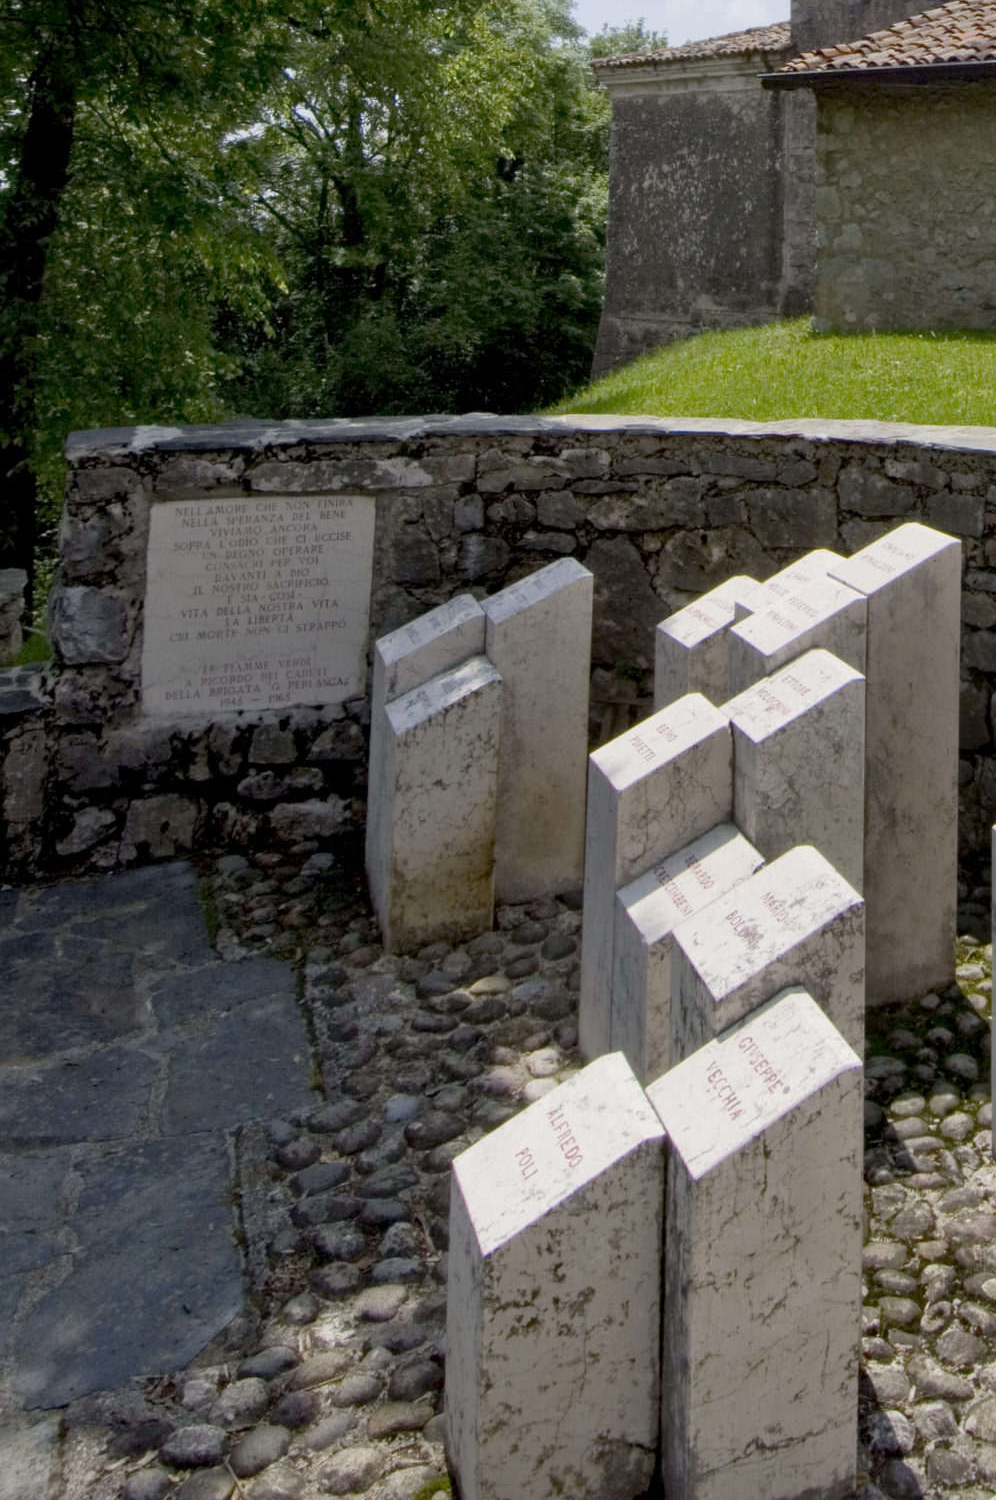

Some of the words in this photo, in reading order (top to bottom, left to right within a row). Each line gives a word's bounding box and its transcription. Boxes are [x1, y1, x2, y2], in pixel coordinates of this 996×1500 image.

[256, 502, 278, 512] CHE
[286, 499, 310, 510] NON
[182, 516, 218, 528] NELLA
[226, 513, 284, 525] SPERANZA
[292, 511, 311, 521] DEL
[320, 509, 346, 520] BENE
[210, 526, 262, 538] VIVIAMO
[270, 523, 317, 534] ANCORA
[266, 535, 288, 546] CHE
[296, 534, 307, 544] CI
[314, 531, 352, 542] UCCISE
[202, 551, 217, 561] UN
[225, 548, 265, 560] DEGNO
[273, 544, 324, 557] OPERARE
[205, 559, 264, 572] CONSACRI
[271, 557, 290, 568] PER
[300, 555, 319, 565] VOI
[214, 570, 266, 584] DAVANTI
[275, 570, 282, 579] A
[290, 567, 310, 578] DIO
[193, 585, 205, 596] IL
[212, 582, 259, 594] NOSTRO
[227, 594, 234, 604] E
[241, 593, 258, 604] SIA
[181, 608, 208, 619] VITA
[216, 605, 251, 617] DELLA
[259, 601, 303, 613] NOSTRA
[312, 598, 339, 610] VITA
[225, 616, 239, 627] LA
[169, 631, 189, 643] CUI
[196, 628, 238, 642] MORTE
[246, 626, 270, 637] NON
[278, 624, 289, 634] CI
[203, 664, 217, 675] LE
[224, 660, 270, 674] FIAMME
[278, 657, 311, 670] VERDI
[184, 679, 192, 689] A
[201, 674, 253, 687] RICORDO
[261, 671, 279, 682] DEI
[287, 667, 327, 680] CADUTI
[781, 674, 812, 697] ETTORE
[165, 689, 200, 701] DELLA
[209, 684, 260, 698] BRIGATA
[220, 696, 243, 708] 1945
[268, 692, 291, 703] 1965
[684, 855, 715, 891] BERARDO
[760, 891, 790, 922] MARIO
[737, 1036, 782, 1095] GIVSEPPE
[705, 1061, 742, 1122] VECCHIA
[546, 1107, 583, 1169] ALFREDO
[515, 1147, 539, 1180] POLI
